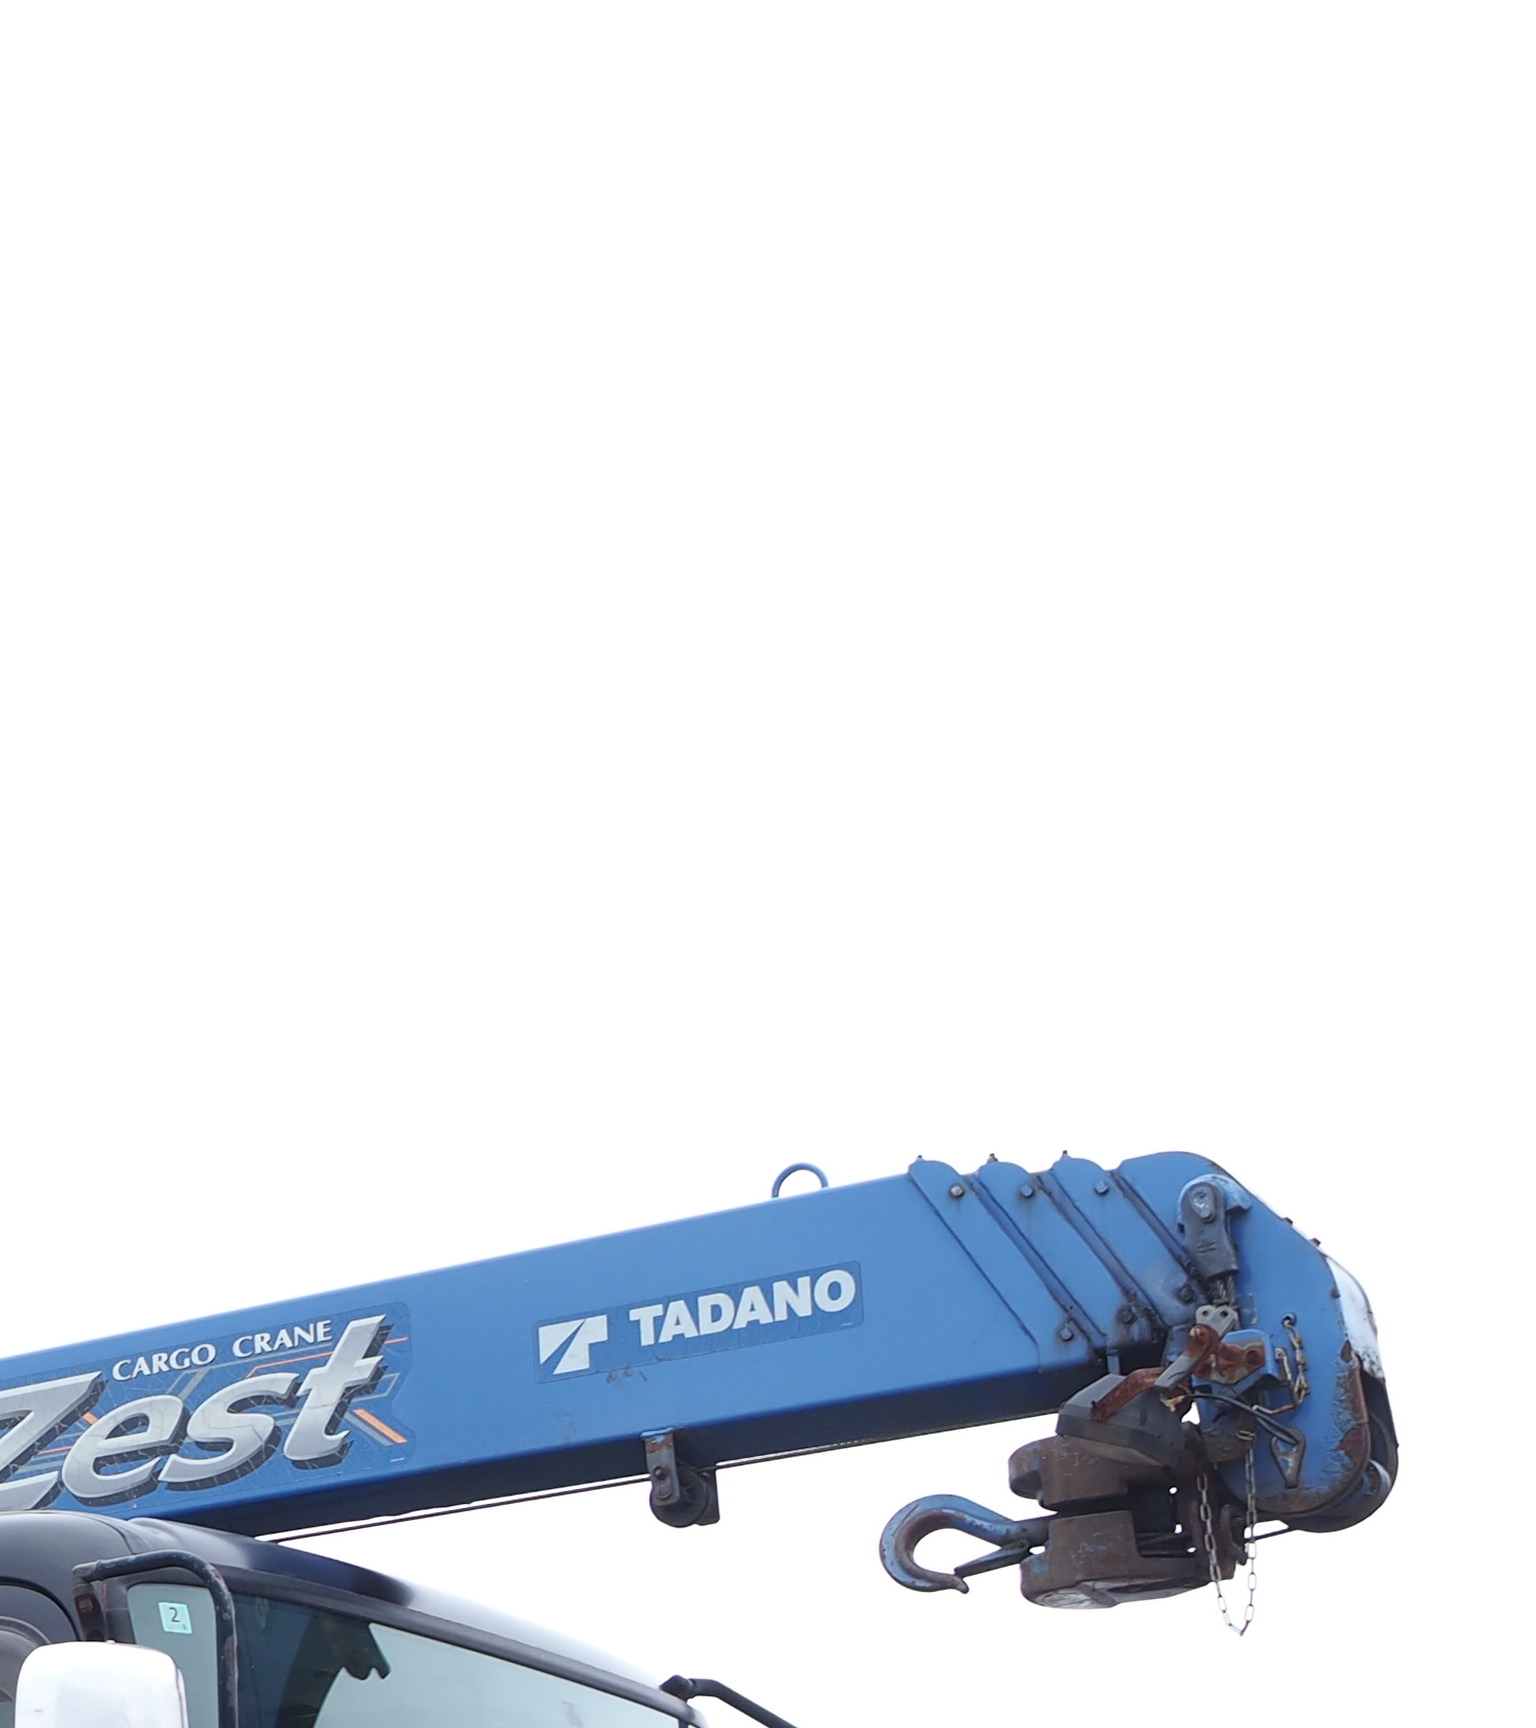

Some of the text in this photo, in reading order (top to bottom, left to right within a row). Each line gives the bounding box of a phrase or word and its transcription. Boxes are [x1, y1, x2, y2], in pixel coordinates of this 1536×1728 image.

[629, 1269, 856, 1346] TADANO
[112, 1319, 334, 1382] CARGO CRANE
[168, 1606, 180, 1623] 2
